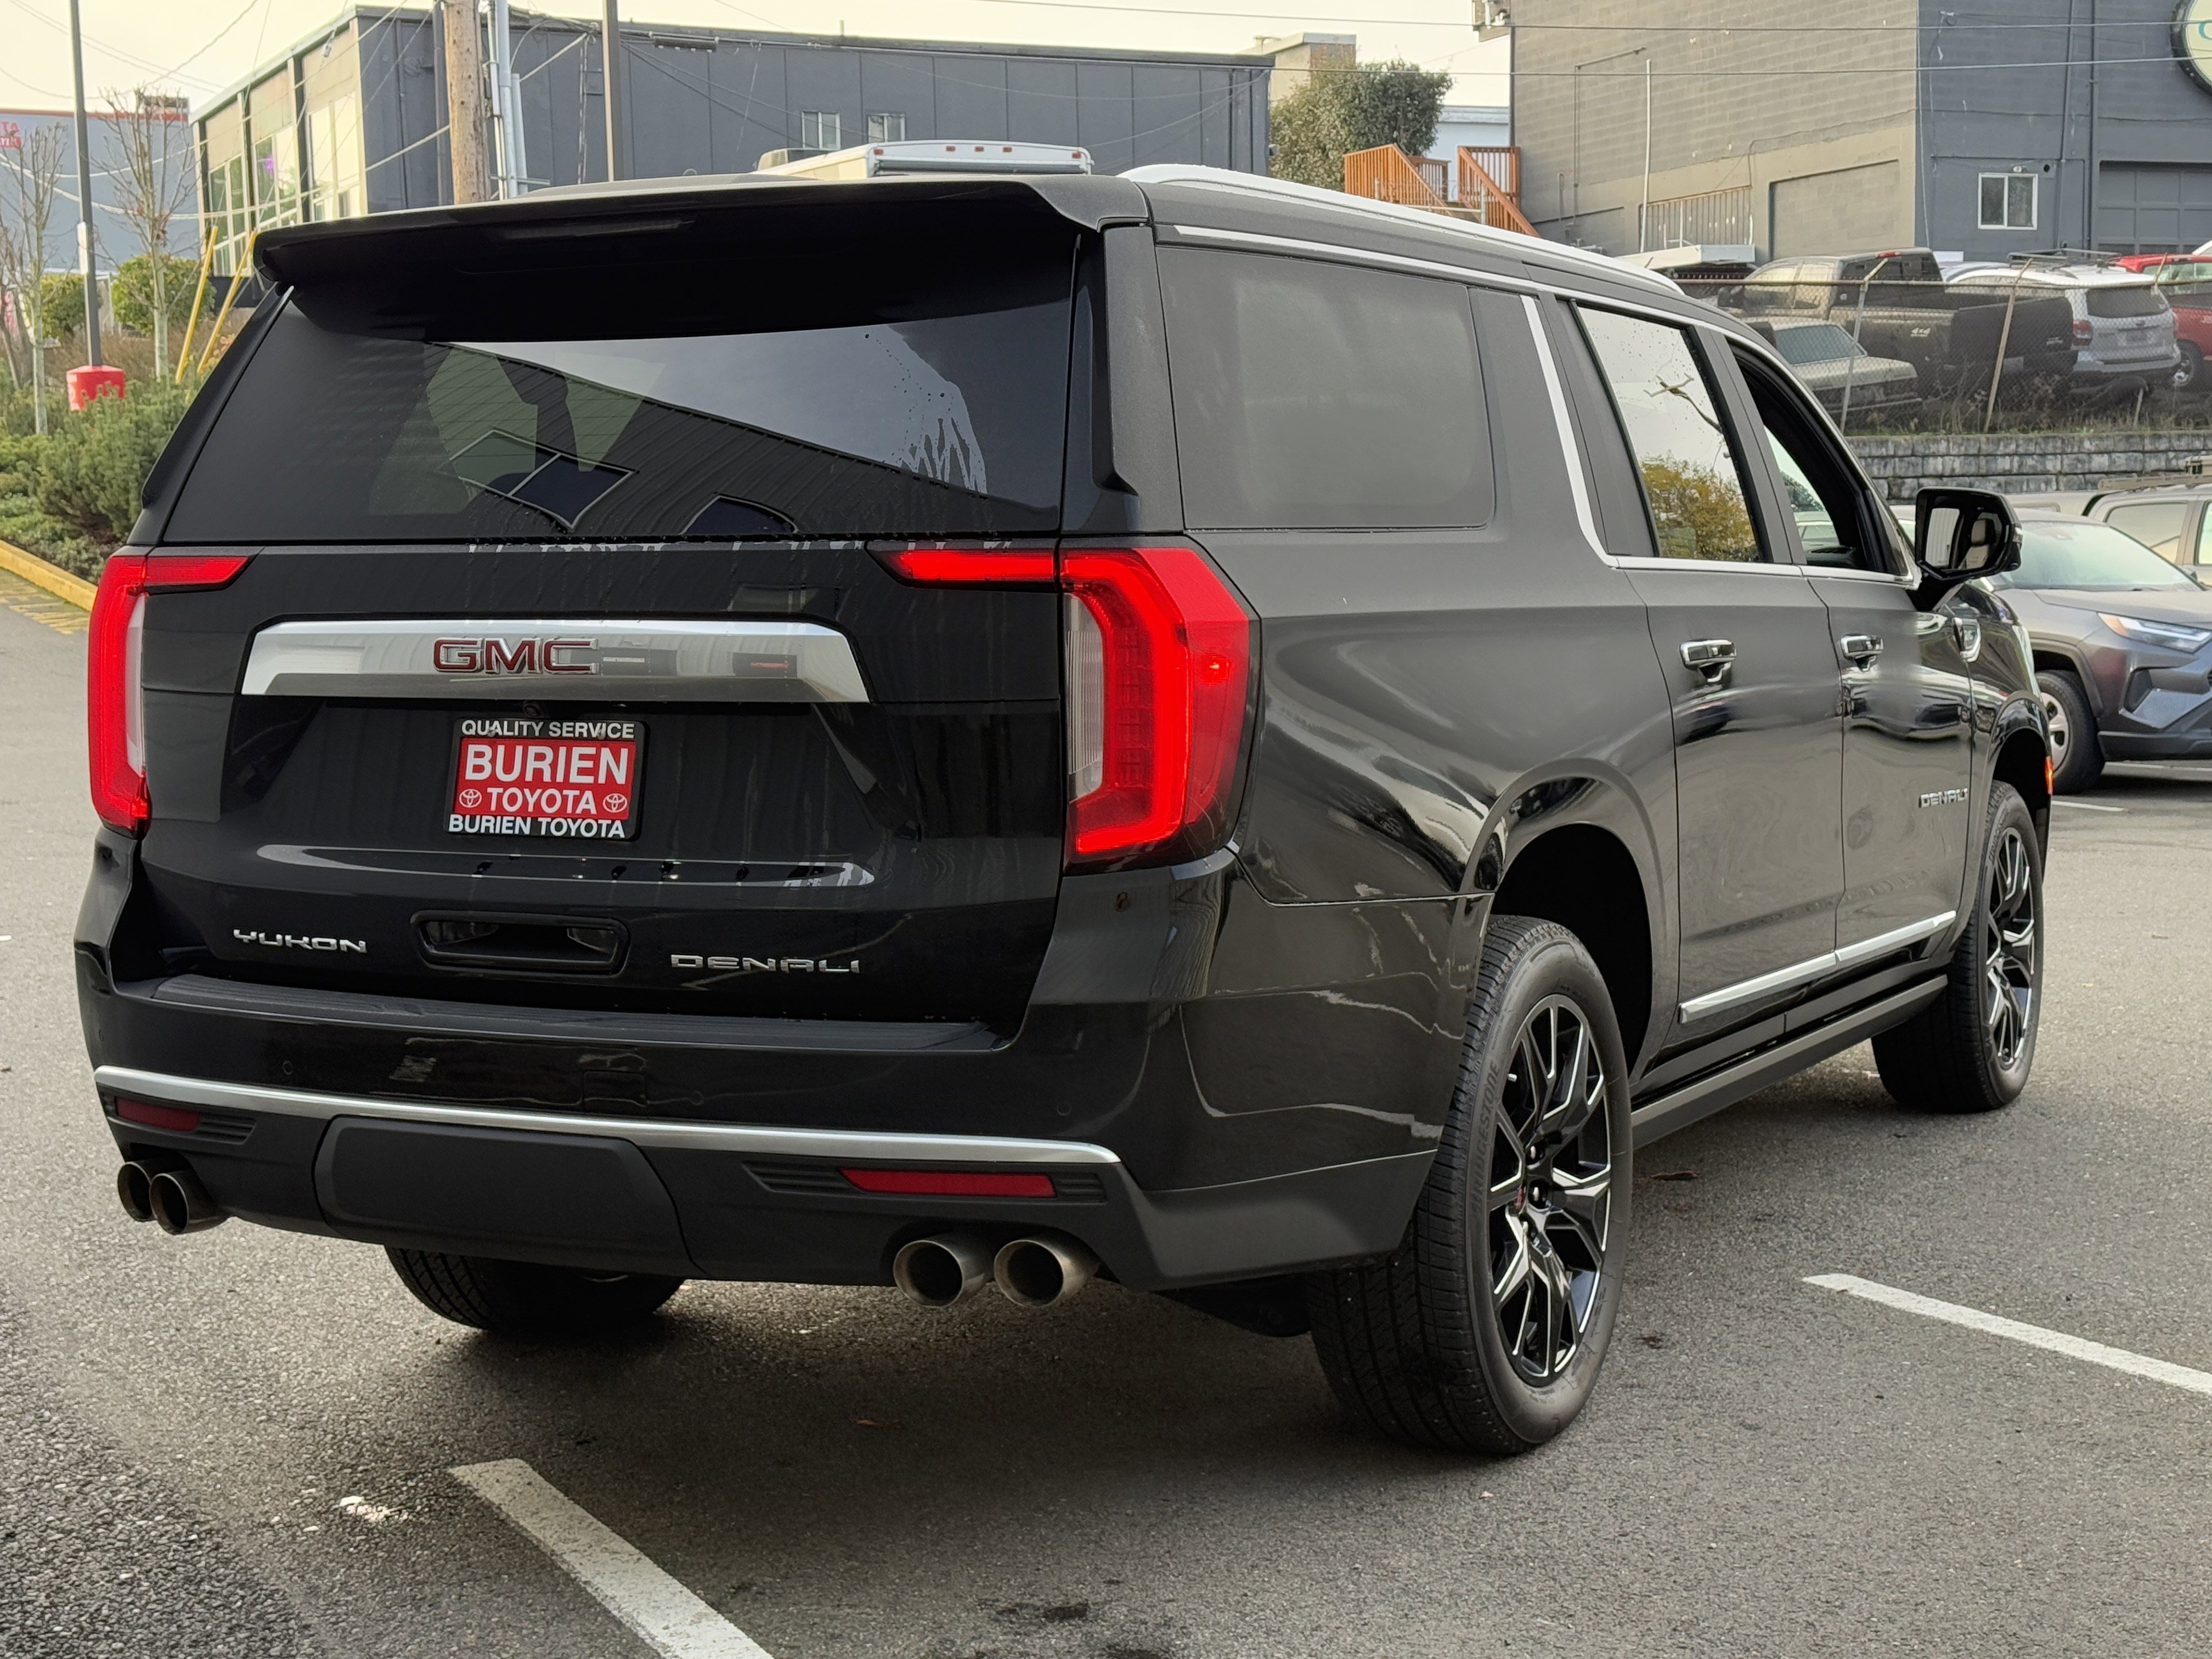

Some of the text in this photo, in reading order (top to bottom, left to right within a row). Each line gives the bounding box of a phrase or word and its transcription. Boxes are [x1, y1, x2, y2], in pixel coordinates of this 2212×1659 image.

[433, 637, 599, 675] GMC
[462, 720, 635, 739] QUALITY SERVICE
[465, 744, 629, 785] BURIEN
[487, 787, 597, 815] TOYOTA
[1920, 788, 1968, 808] DENALI
[449, 814, 625, 838] BURIEN TOYOTA
[233, 929, 367, 953] YUKON
[670, 954, 860, 974] DENALI
